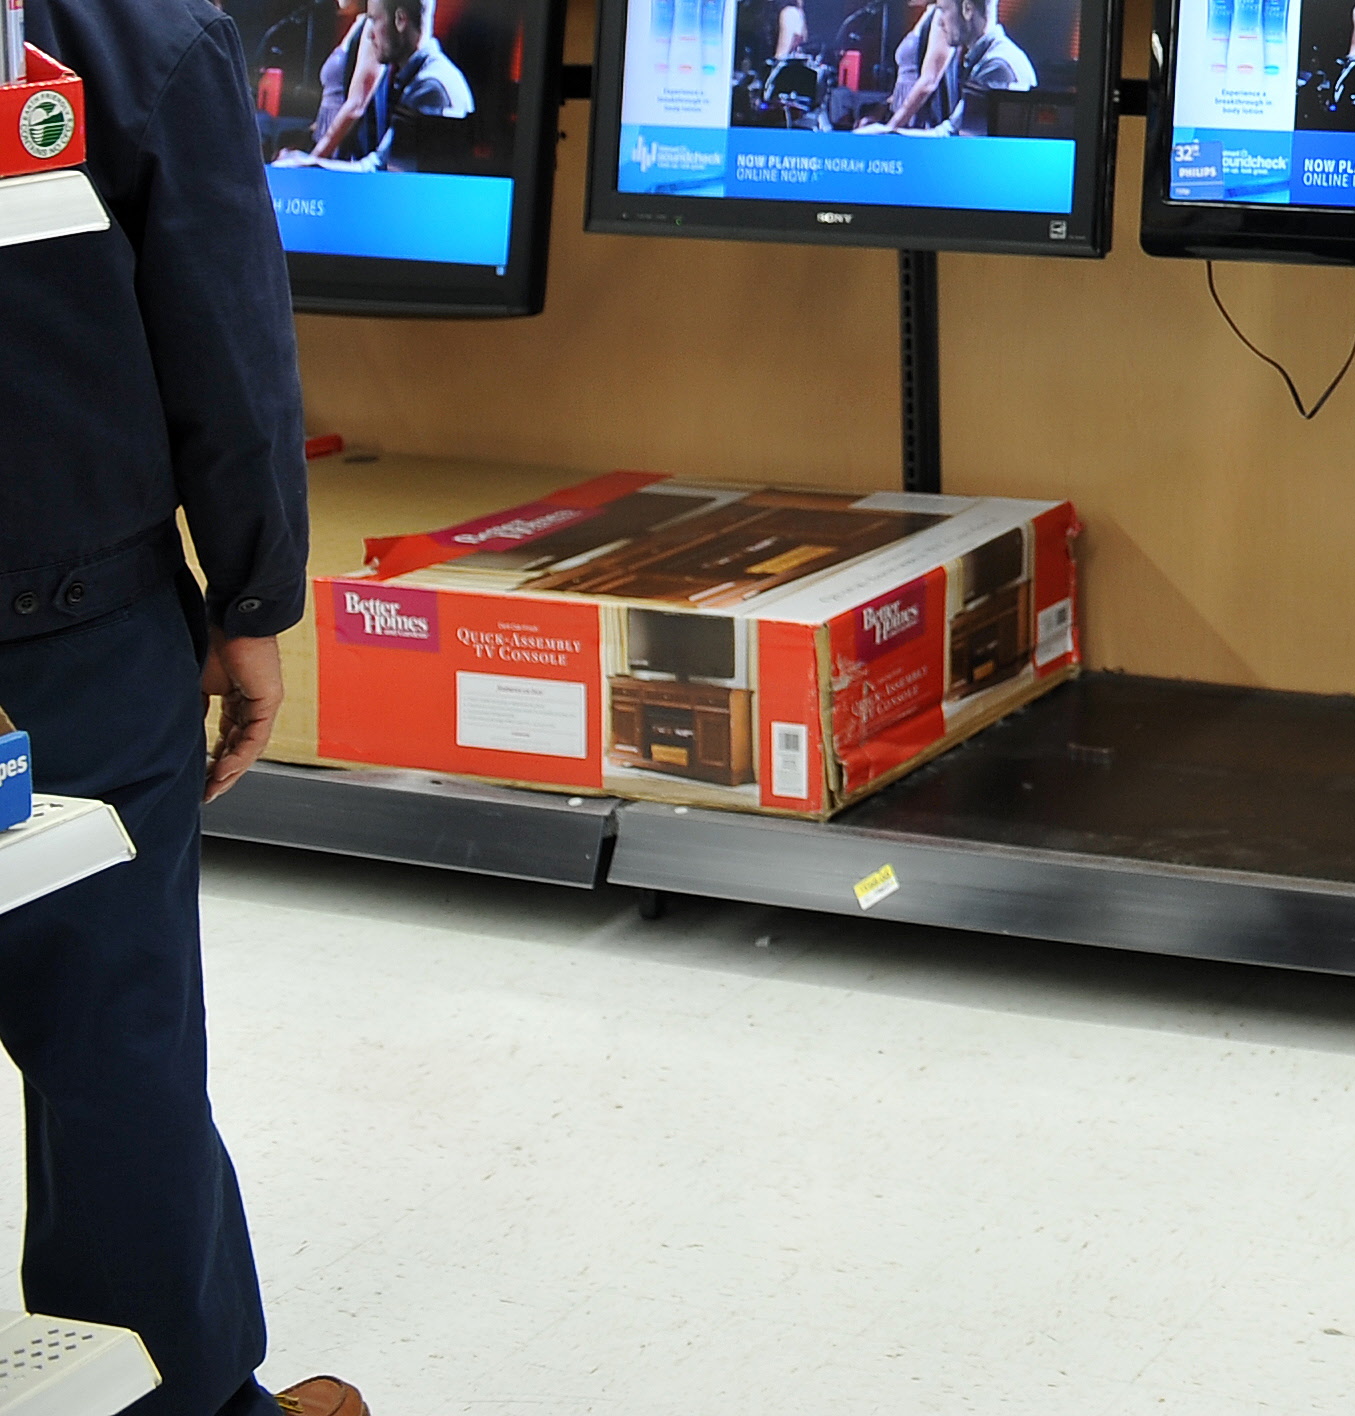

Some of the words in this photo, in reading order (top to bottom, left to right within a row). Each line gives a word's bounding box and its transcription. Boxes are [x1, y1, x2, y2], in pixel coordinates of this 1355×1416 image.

[737, 154, 763, 169] NOW
[768, 155, 822, 170] PLAYING:
[824, 158, 865, 173] NORAH
[867, 160, 904, 175] JONES
[1222, 155, 1287, 170] oundcheck
[1304, 159, 1336, 173] NOW
[736, 168, 777, 183] ONLINE
[780, 170, 808, 183] NOW
[1303, 173, 1349, 188] ONLINE
[285, 198, 325, 216] JONES
[816, 212, 853, 224] SONY
[344, 591, 401, 618] Better
[362, 612, 429, 636] Homes
[473, 643, 494, 659] TV
[499, 645, 568, 667] CONSOLE
